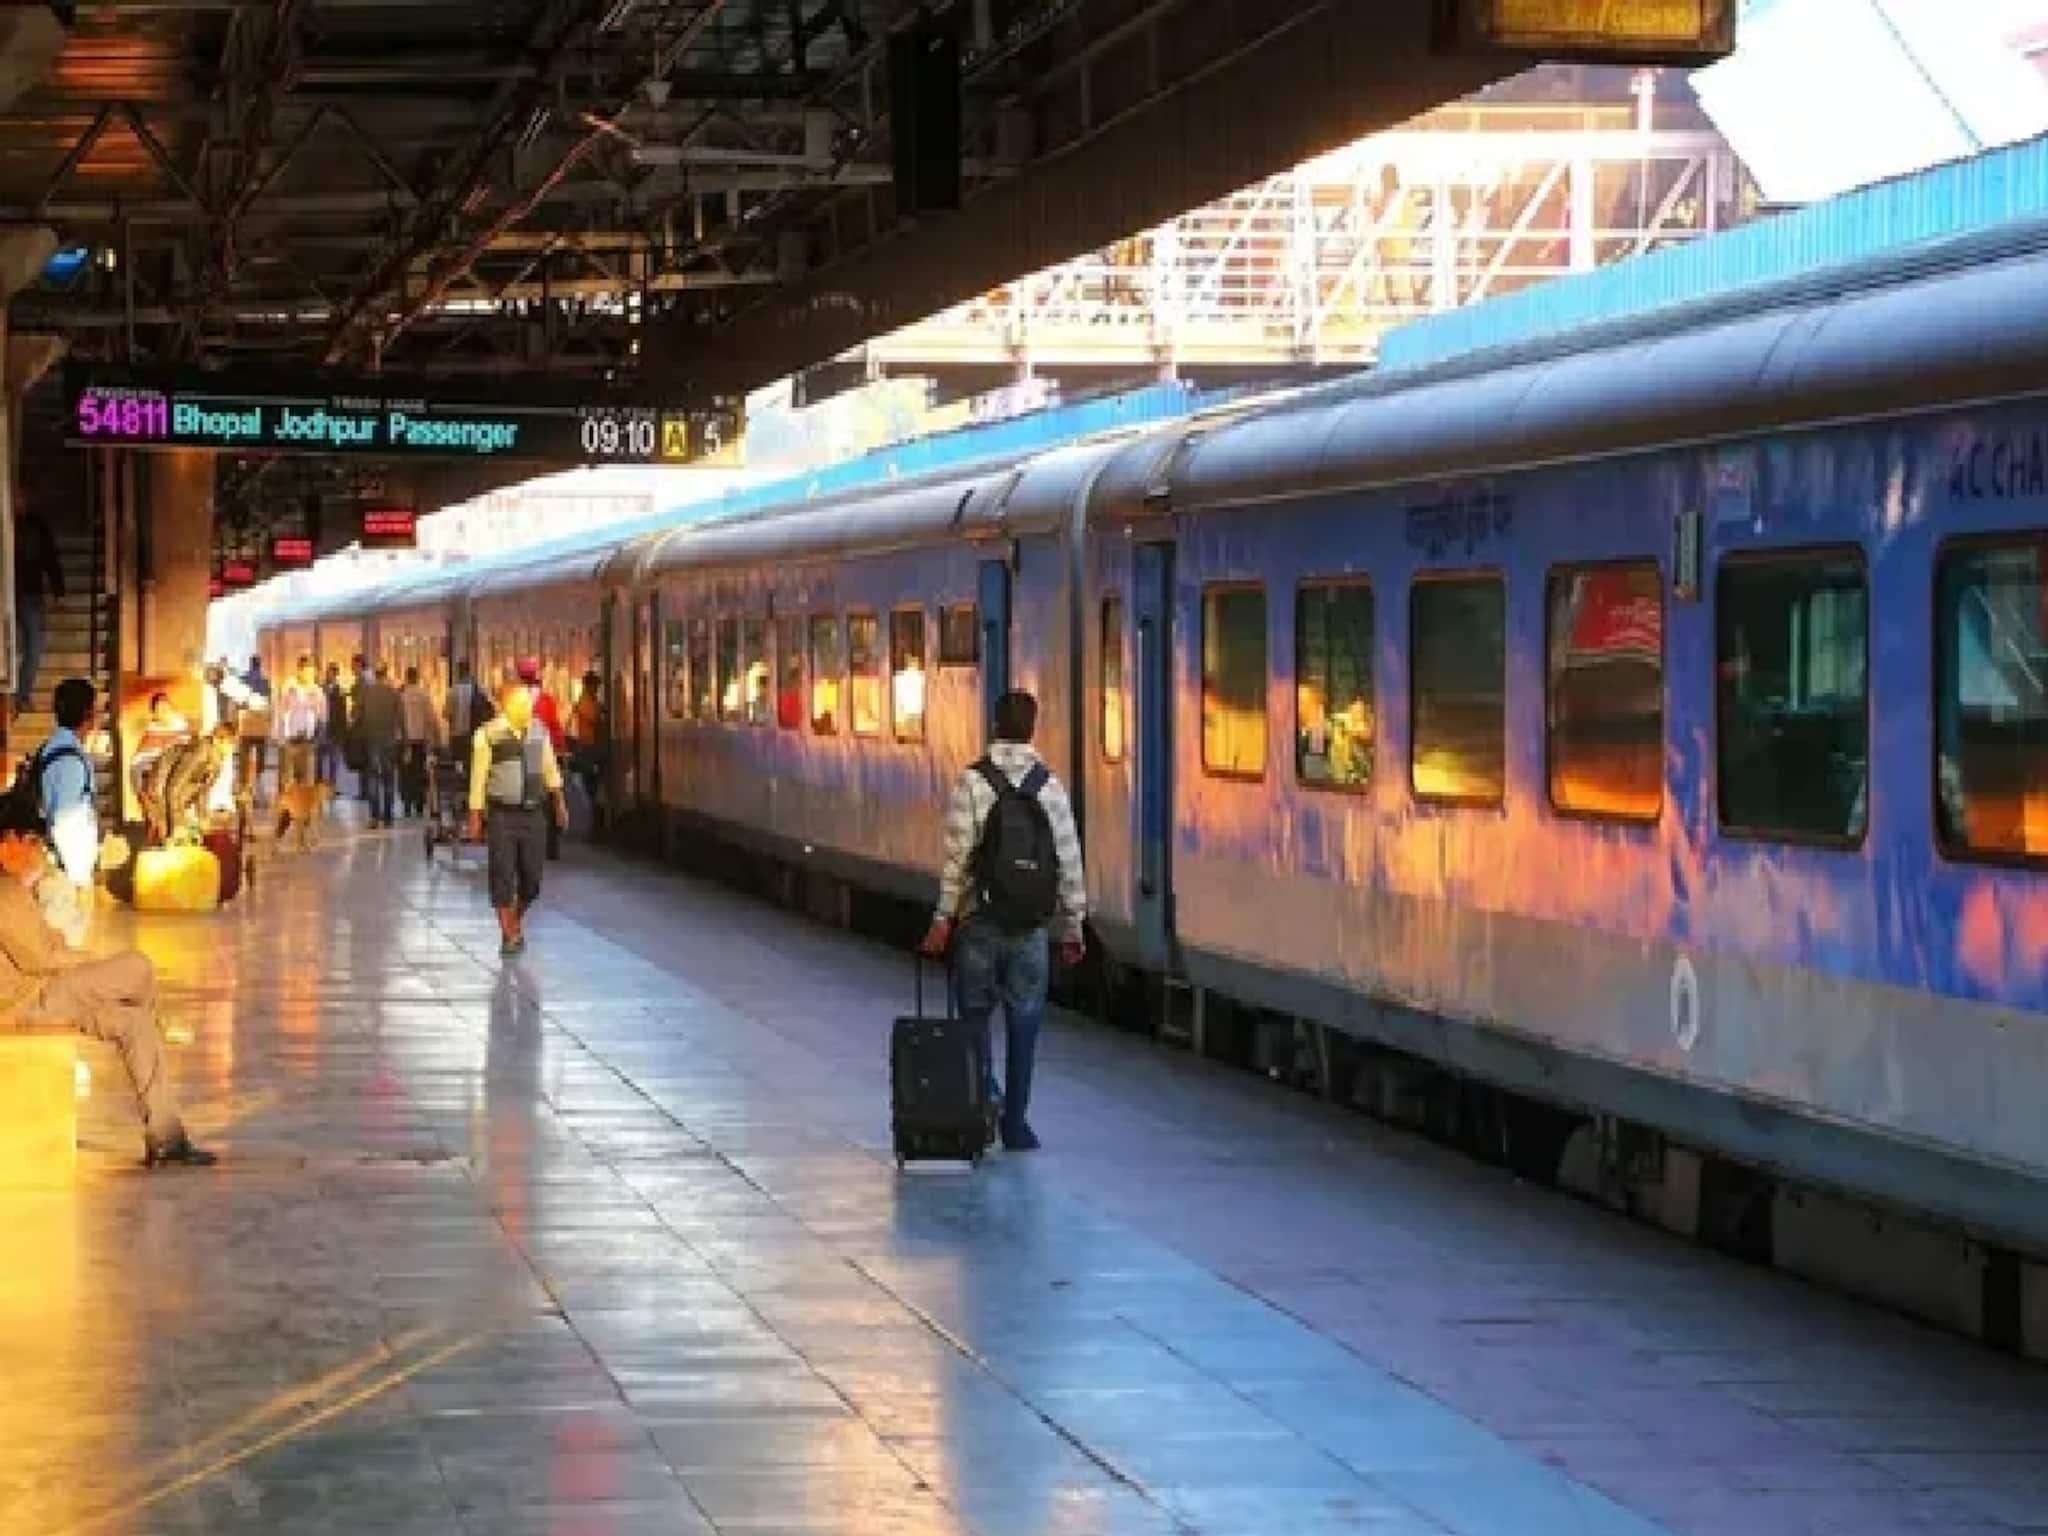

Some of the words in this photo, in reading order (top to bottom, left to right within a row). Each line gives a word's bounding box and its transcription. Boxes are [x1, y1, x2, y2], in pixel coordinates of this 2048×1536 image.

[79, 396, 167, 439] 54811
[173, 403, 261, 440] Bhopal
[274, 407, 378, 444] Jodhpur
[389, 411, 518, 453] Passenger
[580, 414, 656, 454] 09:10
